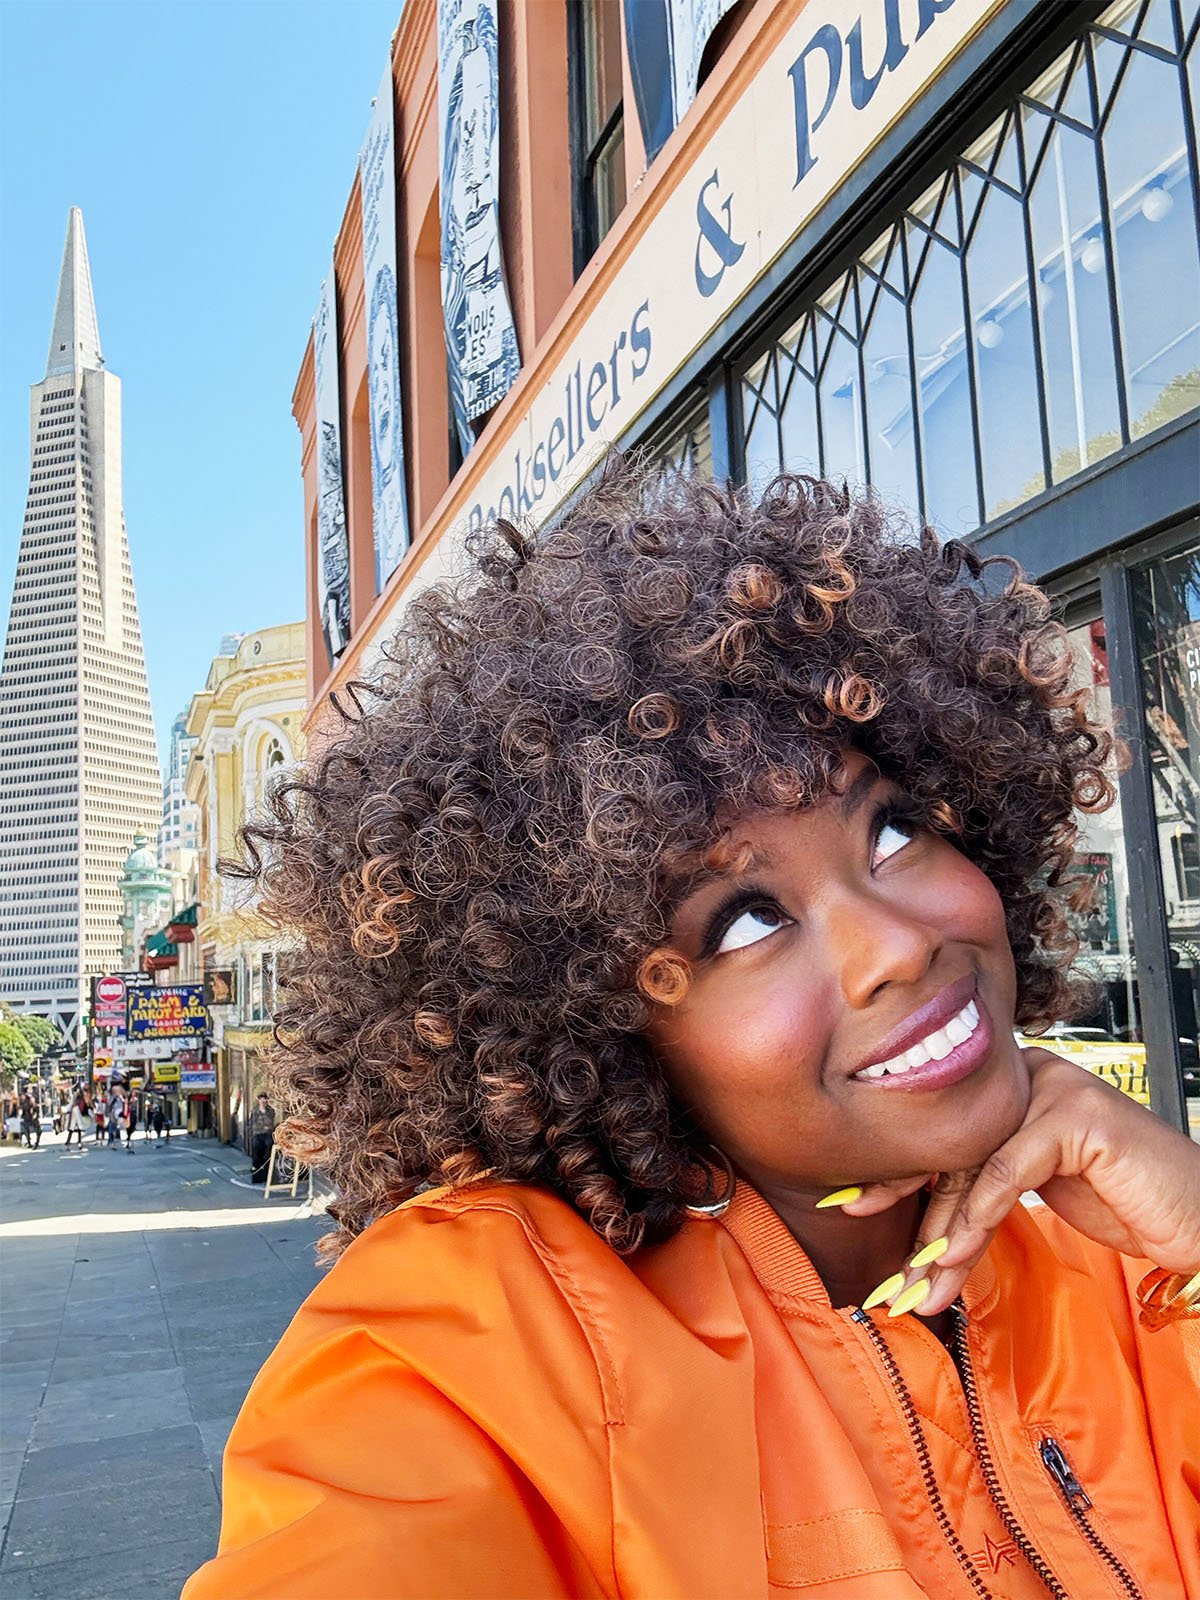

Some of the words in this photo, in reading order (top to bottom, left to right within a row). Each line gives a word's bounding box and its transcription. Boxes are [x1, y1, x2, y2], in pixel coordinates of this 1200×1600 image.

[695, 168, 747, 298] &
[787, 0, 957, 191] Pu
[138, 996, 181, 1009] PALM
[188, 995, 200, 1006] &
[131, 1007, 172, 1020] TAROT
[173, 1005, 206, 1019] CARD
